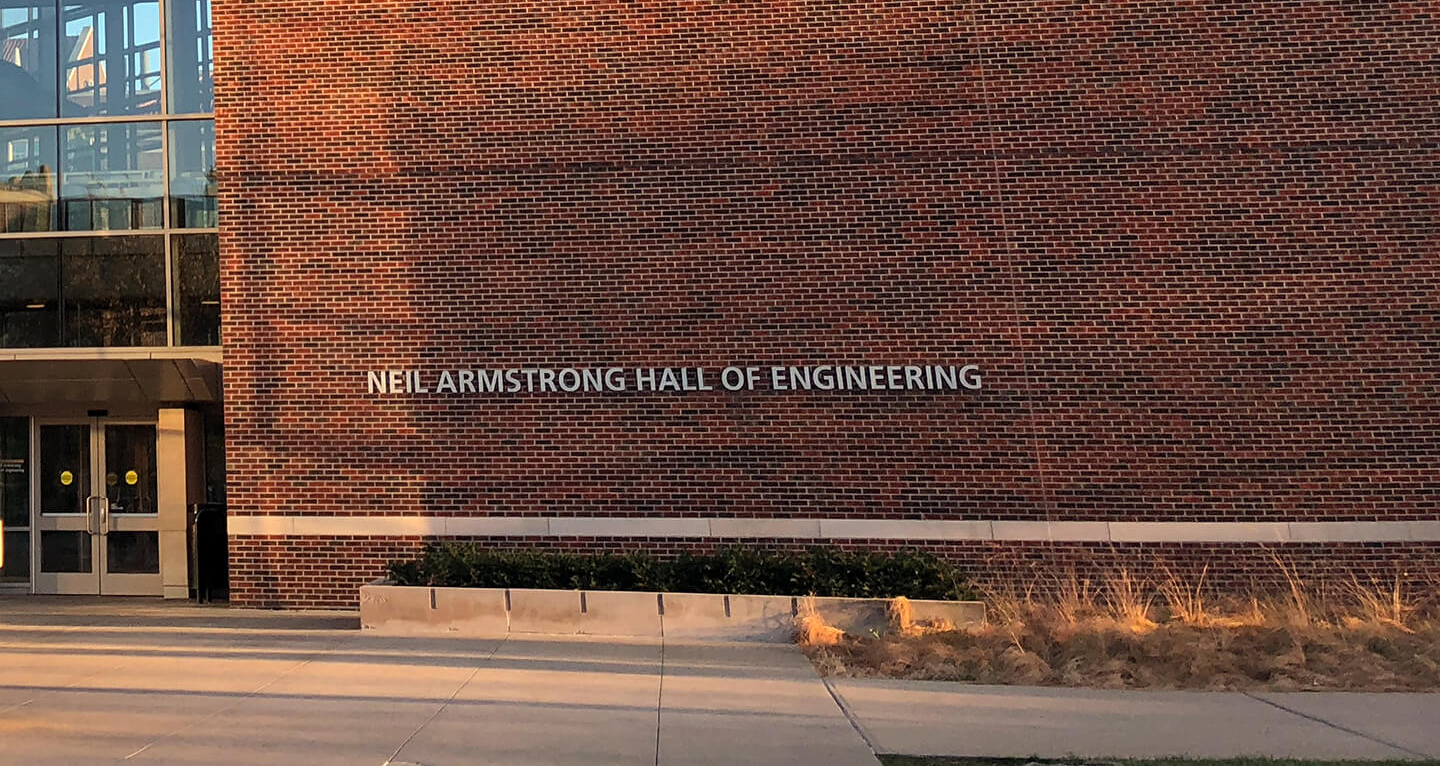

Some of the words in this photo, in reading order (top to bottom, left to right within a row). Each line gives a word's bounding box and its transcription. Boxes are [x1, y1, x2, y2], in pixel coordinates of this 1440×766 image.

[367, 370, 429, 394] NEIL
[436, 367, 626, 394] ARMSTRONG
[636, 367, 713, 392] HALL
[721, 366, 761, 391] OF
[771, 364, 982, 391] ENGINEERING
